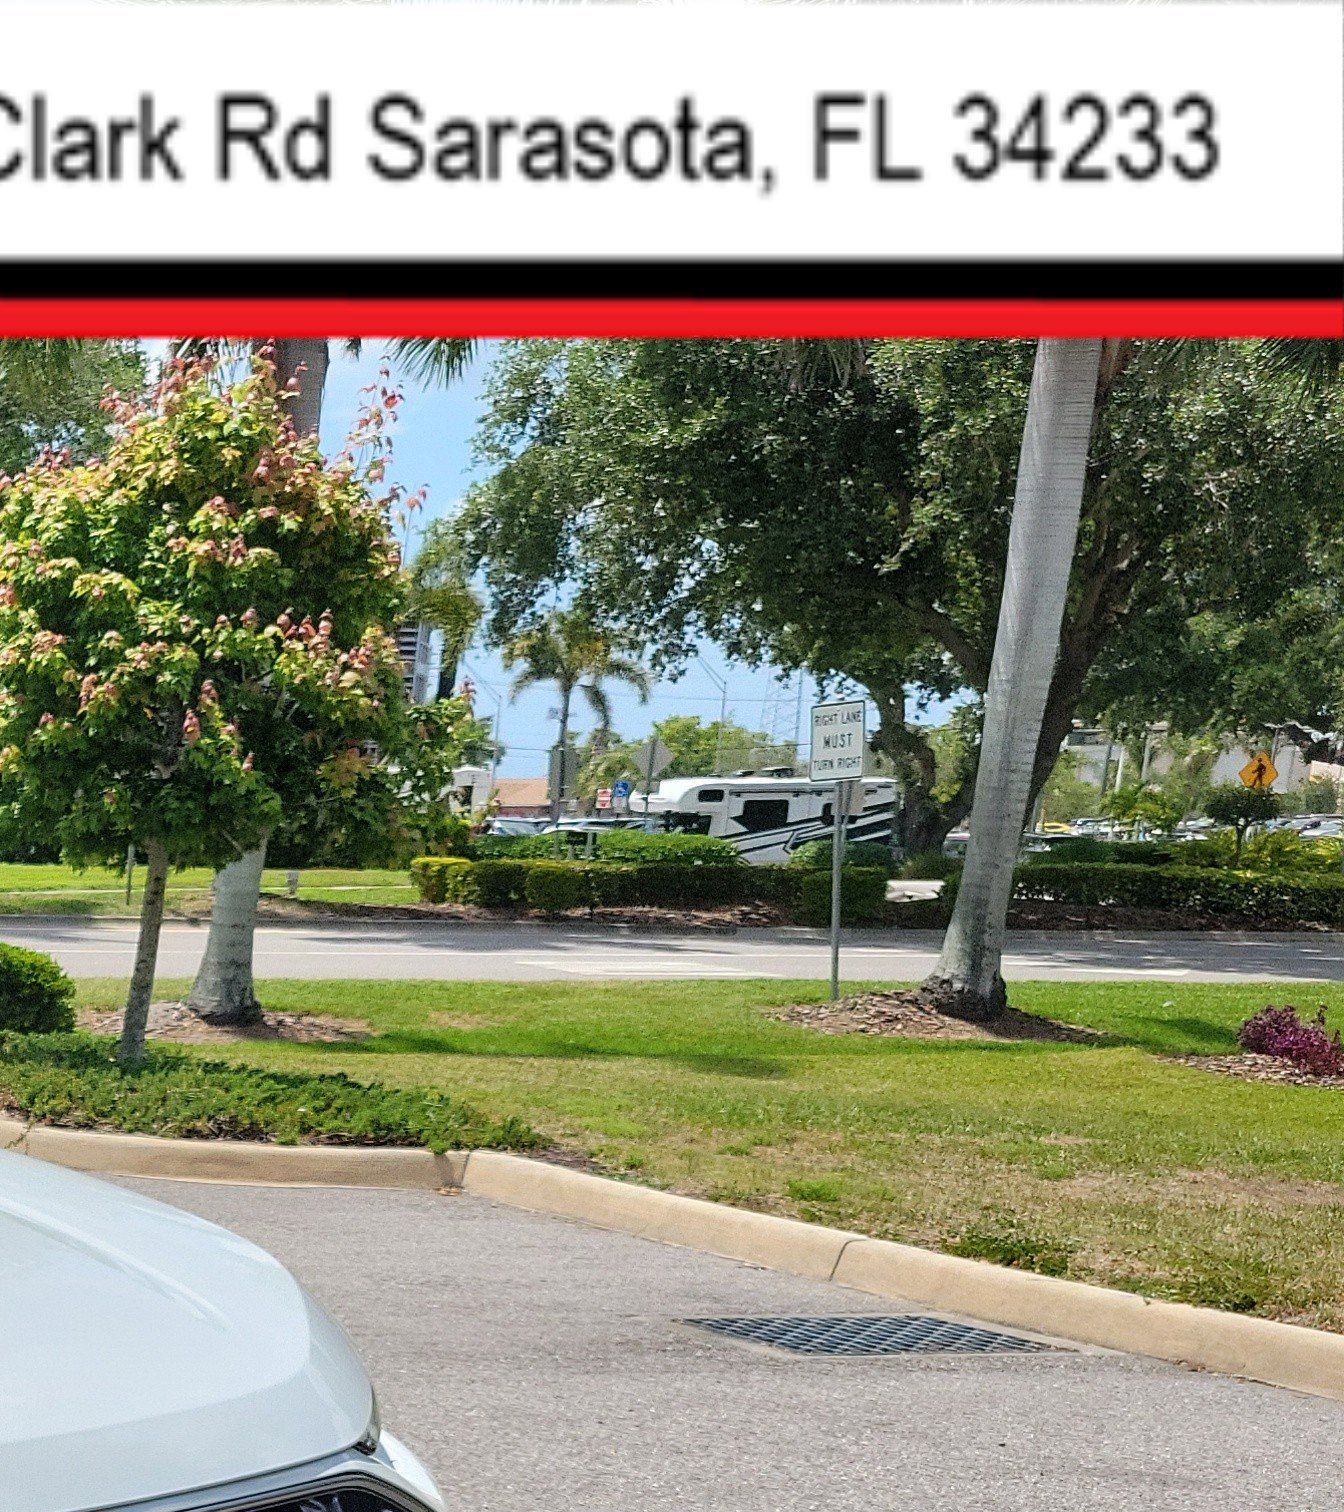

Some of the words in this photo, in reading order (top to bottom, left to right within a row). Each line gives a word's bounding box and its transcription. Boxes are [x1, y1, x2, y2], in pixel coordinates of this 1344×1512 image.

[814, 713, 838, 726] RIGHT
[840, 710, 862, 724] LANE
[823, 732, 853, 748] MUST
